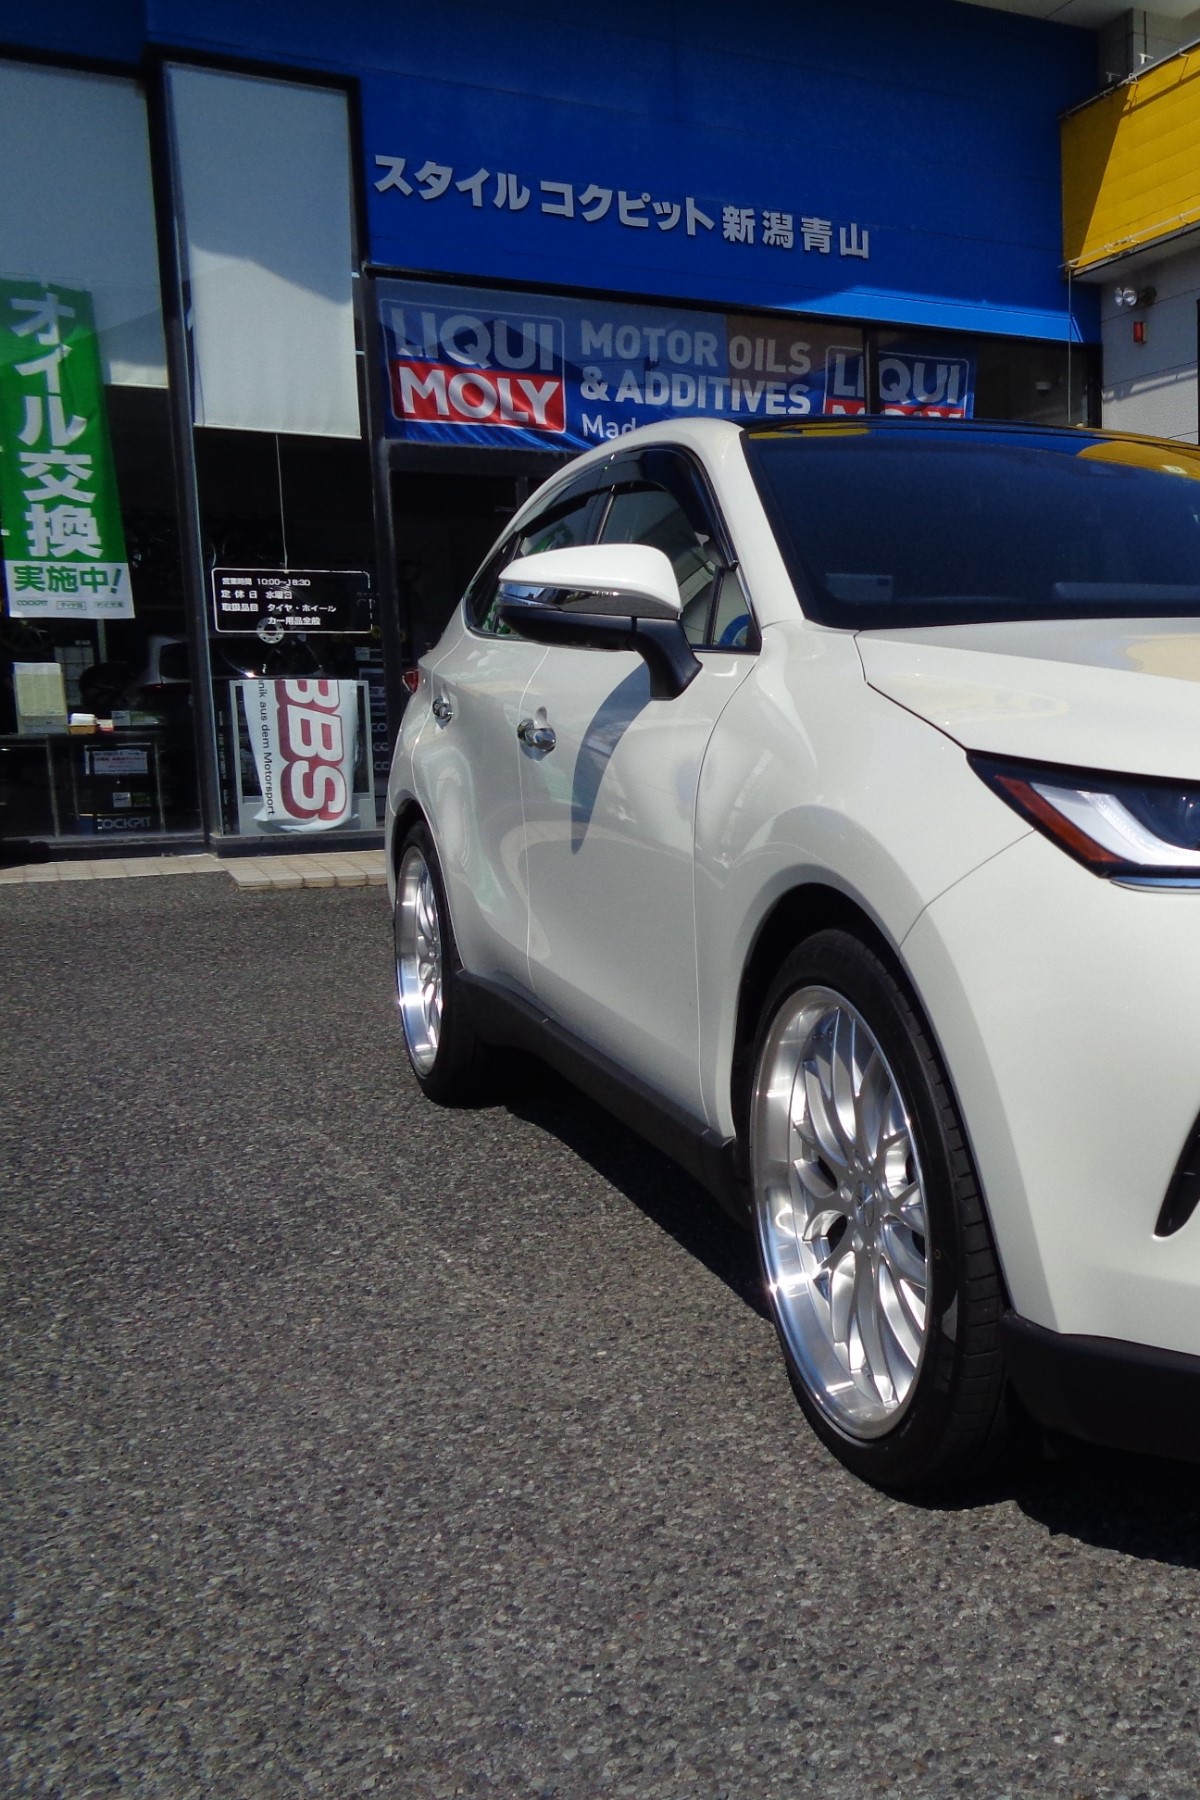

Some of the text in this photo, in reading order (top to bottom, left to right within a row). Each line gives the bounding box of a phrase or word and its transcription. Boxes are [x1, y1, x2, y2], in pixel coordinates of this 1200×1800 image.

[390, 307, 554, 371] LIQUI
[581, 320, 812, 375] MOTOR OILS
[399, 366, 560, 426] MOLY
[580, 366, 812, 415] & ADDITIVES
[833, 353, 960, 405] LIQUI
[10, 292, 104, 559] オイル交換
[581, 413, 642, 439] Mad
[265, 590, 293, 600] 水曜日
[259, 701, 267, 721] aus
[261, 723, 270, 752] dem
[264, 752, 275, 816] Motorsport
